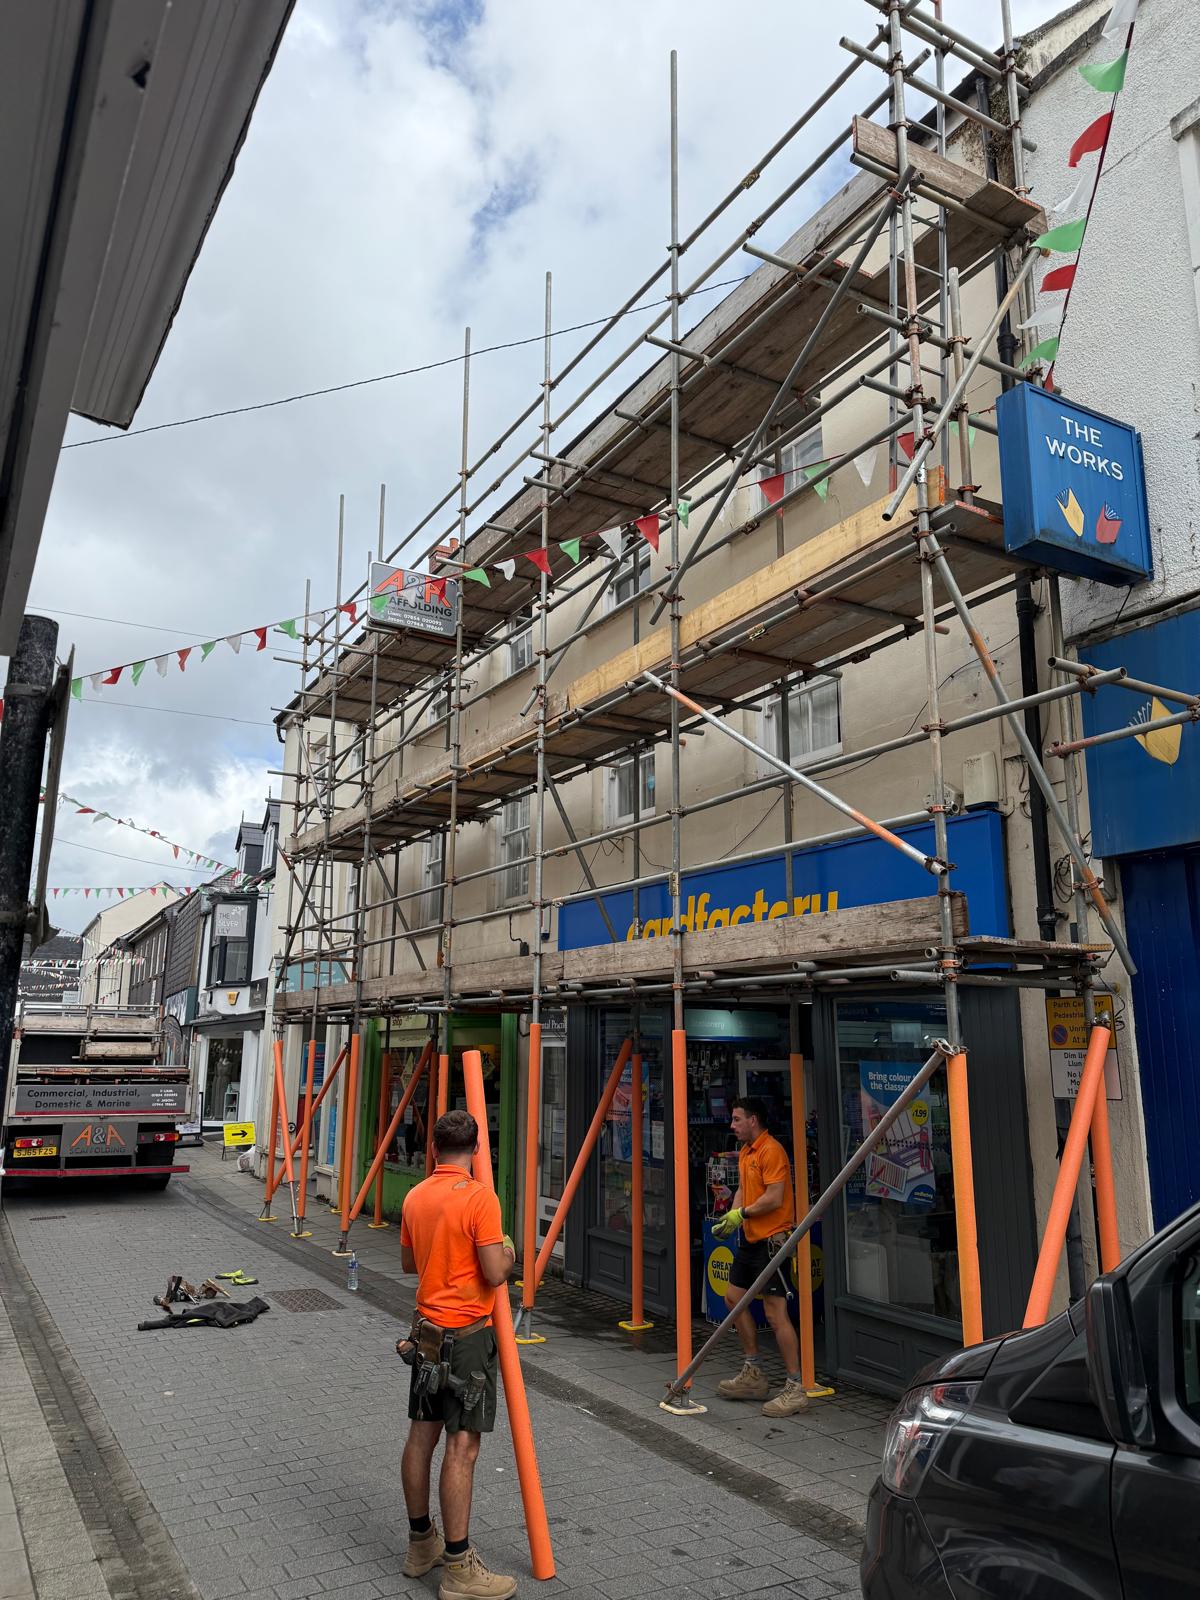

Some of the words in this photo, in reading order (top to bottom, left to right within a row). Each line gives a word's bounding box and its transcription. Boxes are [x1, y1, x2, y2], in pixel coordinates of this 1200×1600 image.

[1060, 415, 1104, 448] THE
[1045, 435, 1124, 481] WORKS
[374, 568, 453, 609] A&A
[388, 596, 452, 617] AFFOLDING
[868, 1072, 888, 1083] Bring
[889, 1073, 912, 1082] colour
[870, 1081, 883, 1090] the
[27, 1089, 89, 1098] Commercial,
[92, 1089, 141, 1098] Industrial,
[35, 1100, 83, 1109] Domestic
[86, 1100, 93, 1108] &
[97, 1099, 131, 1108] Marine
[71, 1124, 127, 1147] A&A
[17, 1149, 37, 1157] SJ65
[38, 1147, 54, 1156] FZS
[712, 1270, 729, 1281] VALU
